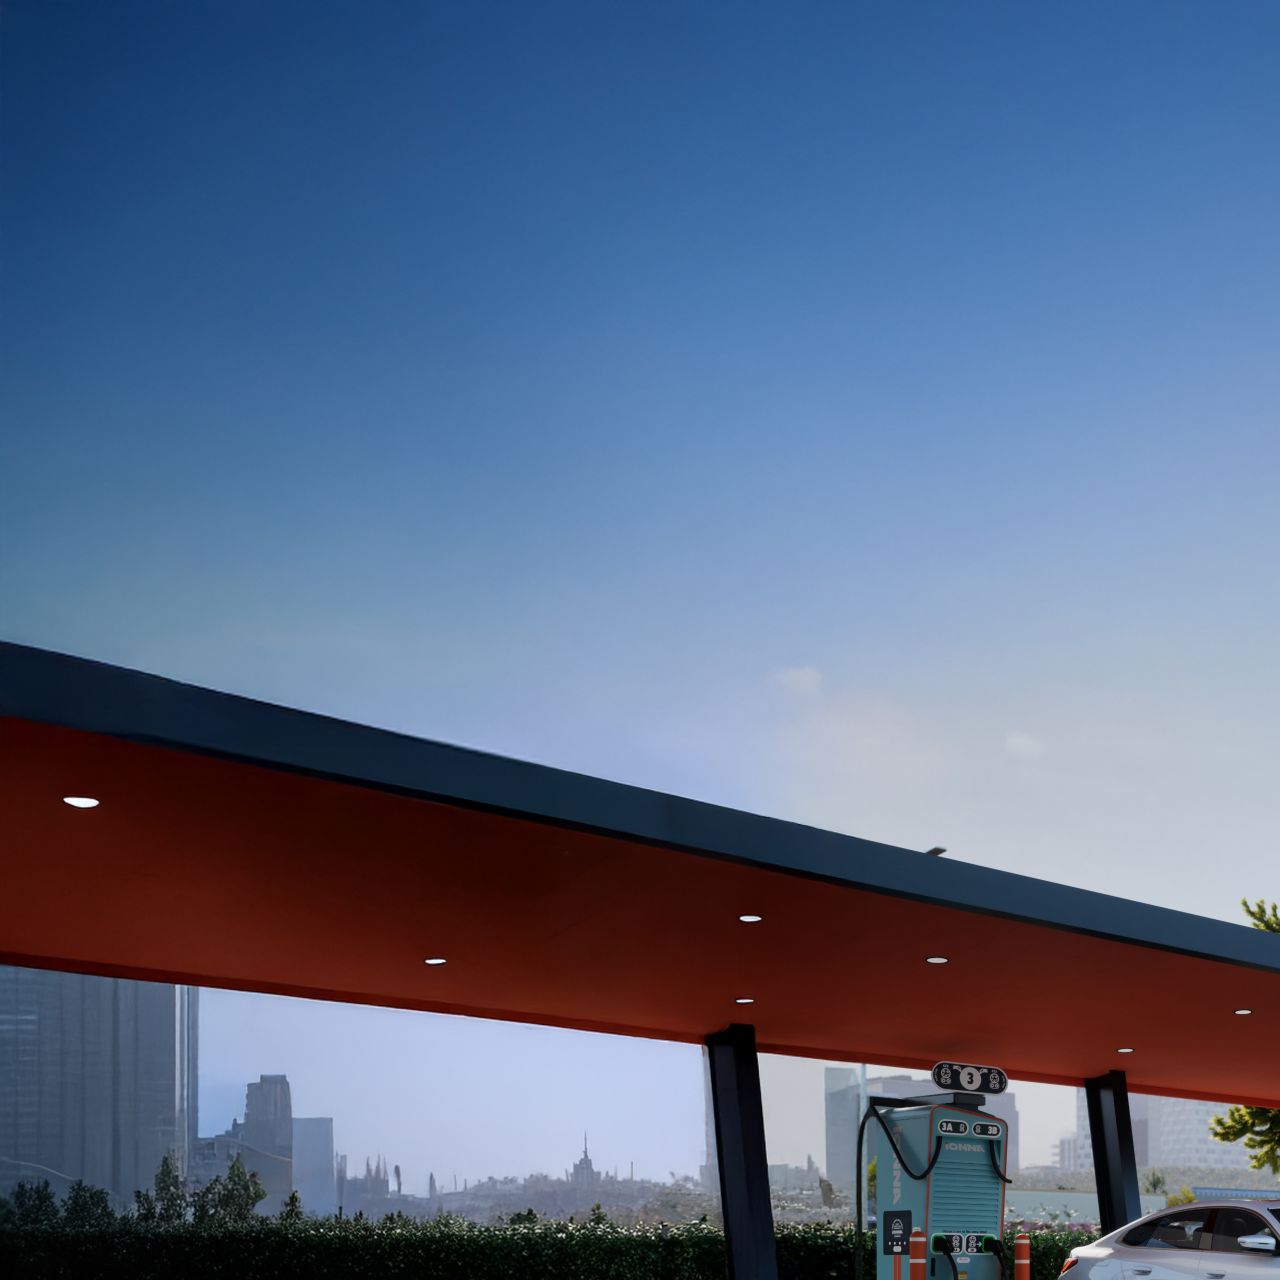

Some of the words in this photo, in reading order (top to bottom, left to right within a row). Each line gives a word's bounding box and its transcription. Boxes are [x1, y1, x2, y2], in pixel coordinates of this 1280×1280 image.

[967, 1072, 974, 1085] 3
[941, 1122, 953, 1131] 3A
[987, 1126, 998, 1134] 3B
